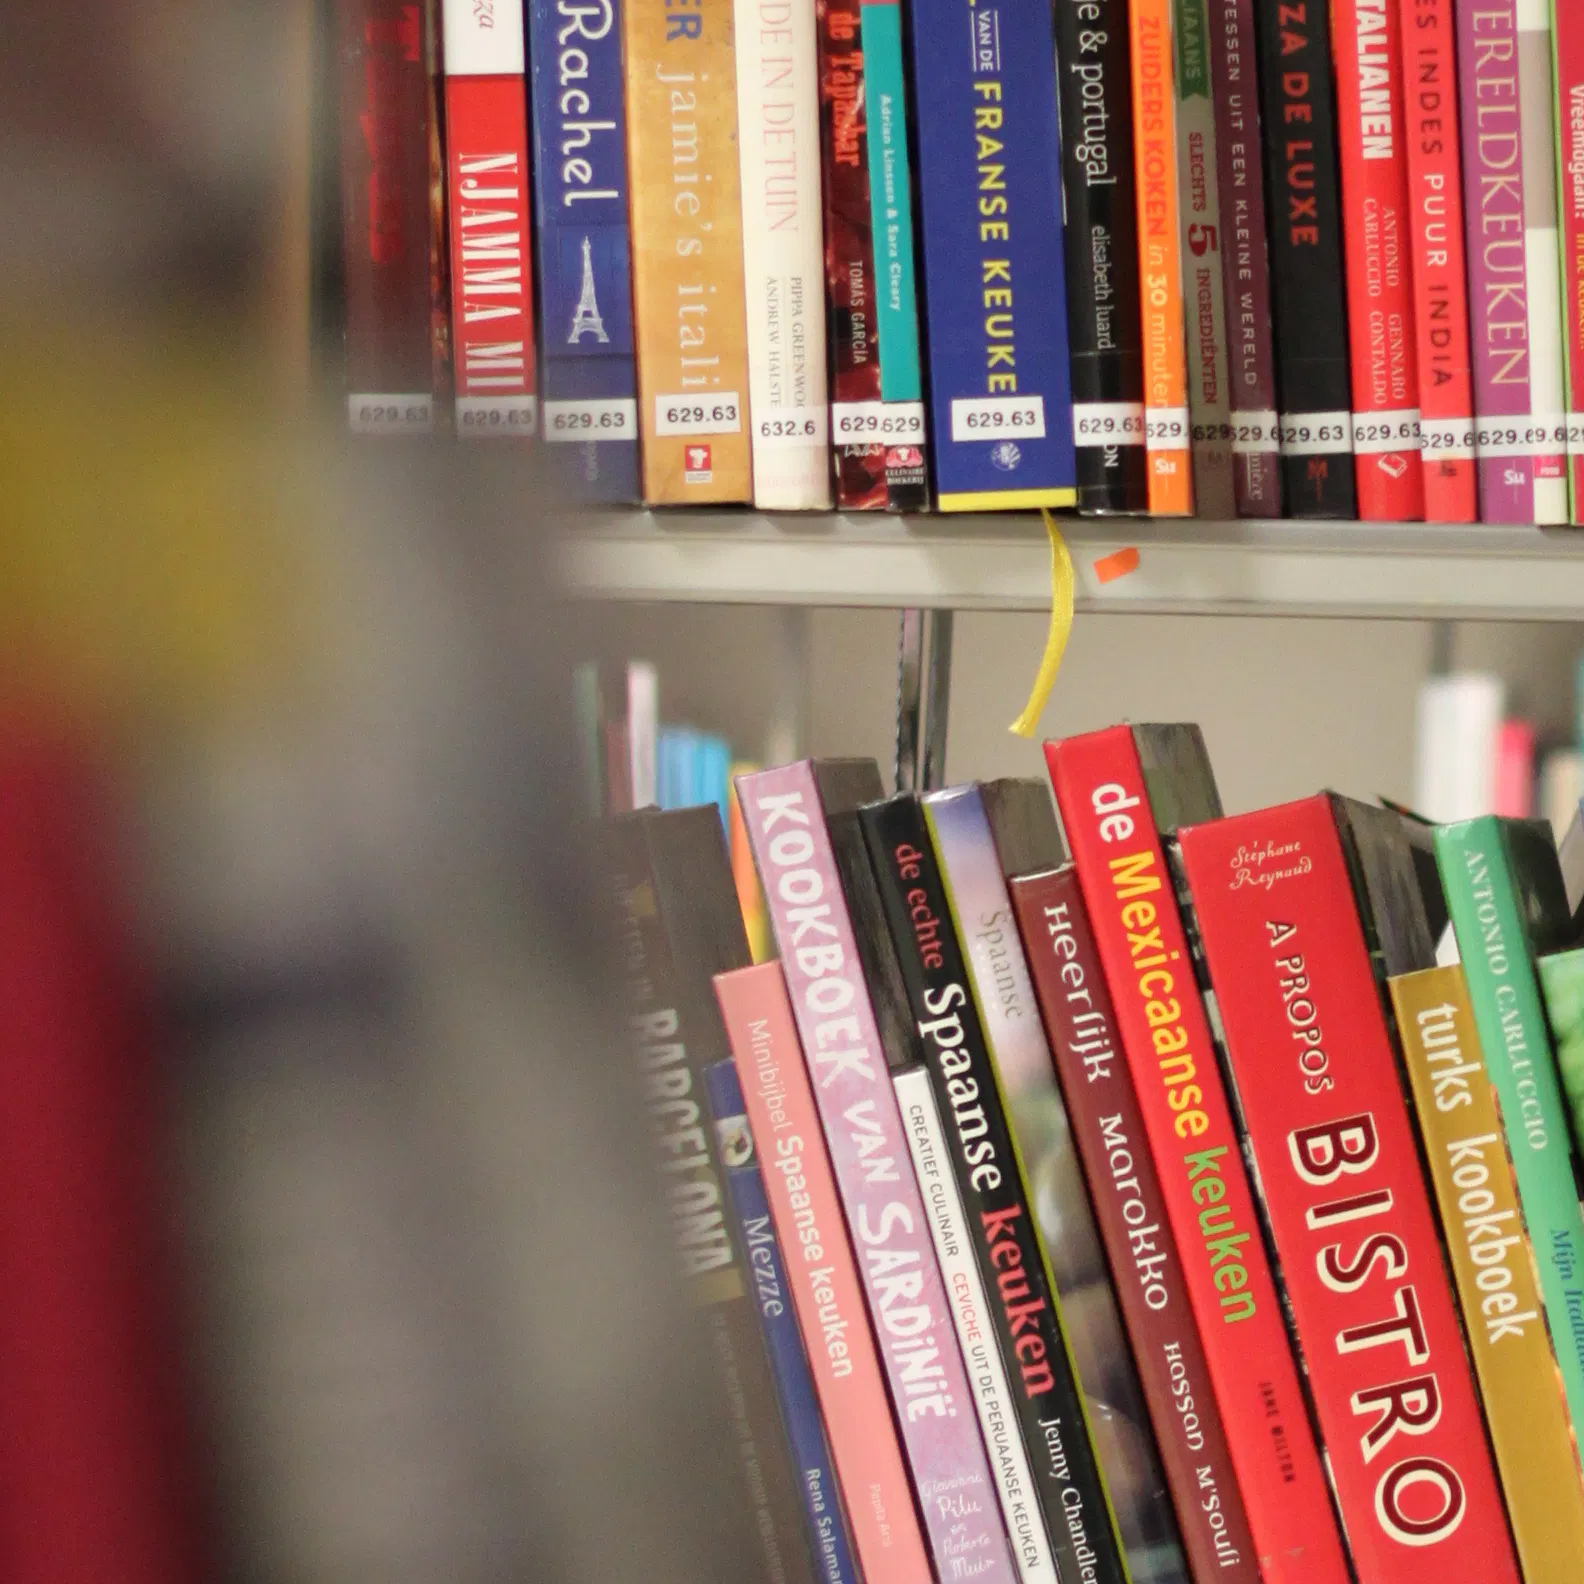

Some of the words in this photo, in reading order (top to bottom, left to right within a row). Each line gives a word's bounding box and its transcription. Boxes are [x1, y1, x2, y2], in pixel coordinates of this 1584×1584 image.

[1079, 29, 1109, 54] &
[1070, 62, 1116, 188] portugal
[1229, 94, 1244, 129] UIT
[1282, 72, 1312, 124] DE
[1419, 47, 1445, 156] INDES
[655, 63, 713, 258] jamie's
[973, 80, 1009, 242] FRANSE
[1232, 144, 1248, 188] EEN
[1284, 139, 1319, 246] LUXE
[1188, 222, 1219, 257] 5
[1235, 199, 1252, 281] KLEINE
[1383, 207, 1401, 286] ANTONIO
[1423, 172, 1449, 267] PUUR
[849, 259, 867, 307] TOMÁS
[1148, 274, 1168, 306] 30
[851, 312, 870, 365] GARCÍA
[1241, 292, 1257, 386] WERELD
[1369, 310, 1388, 405] CONTALDO
[1428, 284, 1453, 388] INDIA
[667, 405, 736, 425] 629.63
[760, 420, 816, 438] 632.6
[967, 411, 1037, 429] 629.63
[1090, 781, 1140, 843] de
[895, 843, 922, 881] de
[907, 889, 945, 969] echte
[756, 791, 875, 1089] KOOKBOEK
[843, 1099, 900, 1185] VAN
[1107, 851, 1212, 1139] Mexicaanse
[1275, 952, 1336, 1097] PROPOS
[917, 981, 1003, 1194] Spaanse
[1416, 1002, 1473, 1114] turks
[1446, 1131, 1539, 1346] kookboek
[771, 1133, 826, 1264] Spaanse
[811, 1265, 855, 1379] keuken
[1182, 1144, 1257, 1324] keuken
[952, 1271, 984, 1343] CEVICHE
[977, 1201, 1056, 1398] keuken
[1286, 1110, 1467, 1548] BISTRO
[1038, 1417, 1072, 1489] Jenny
